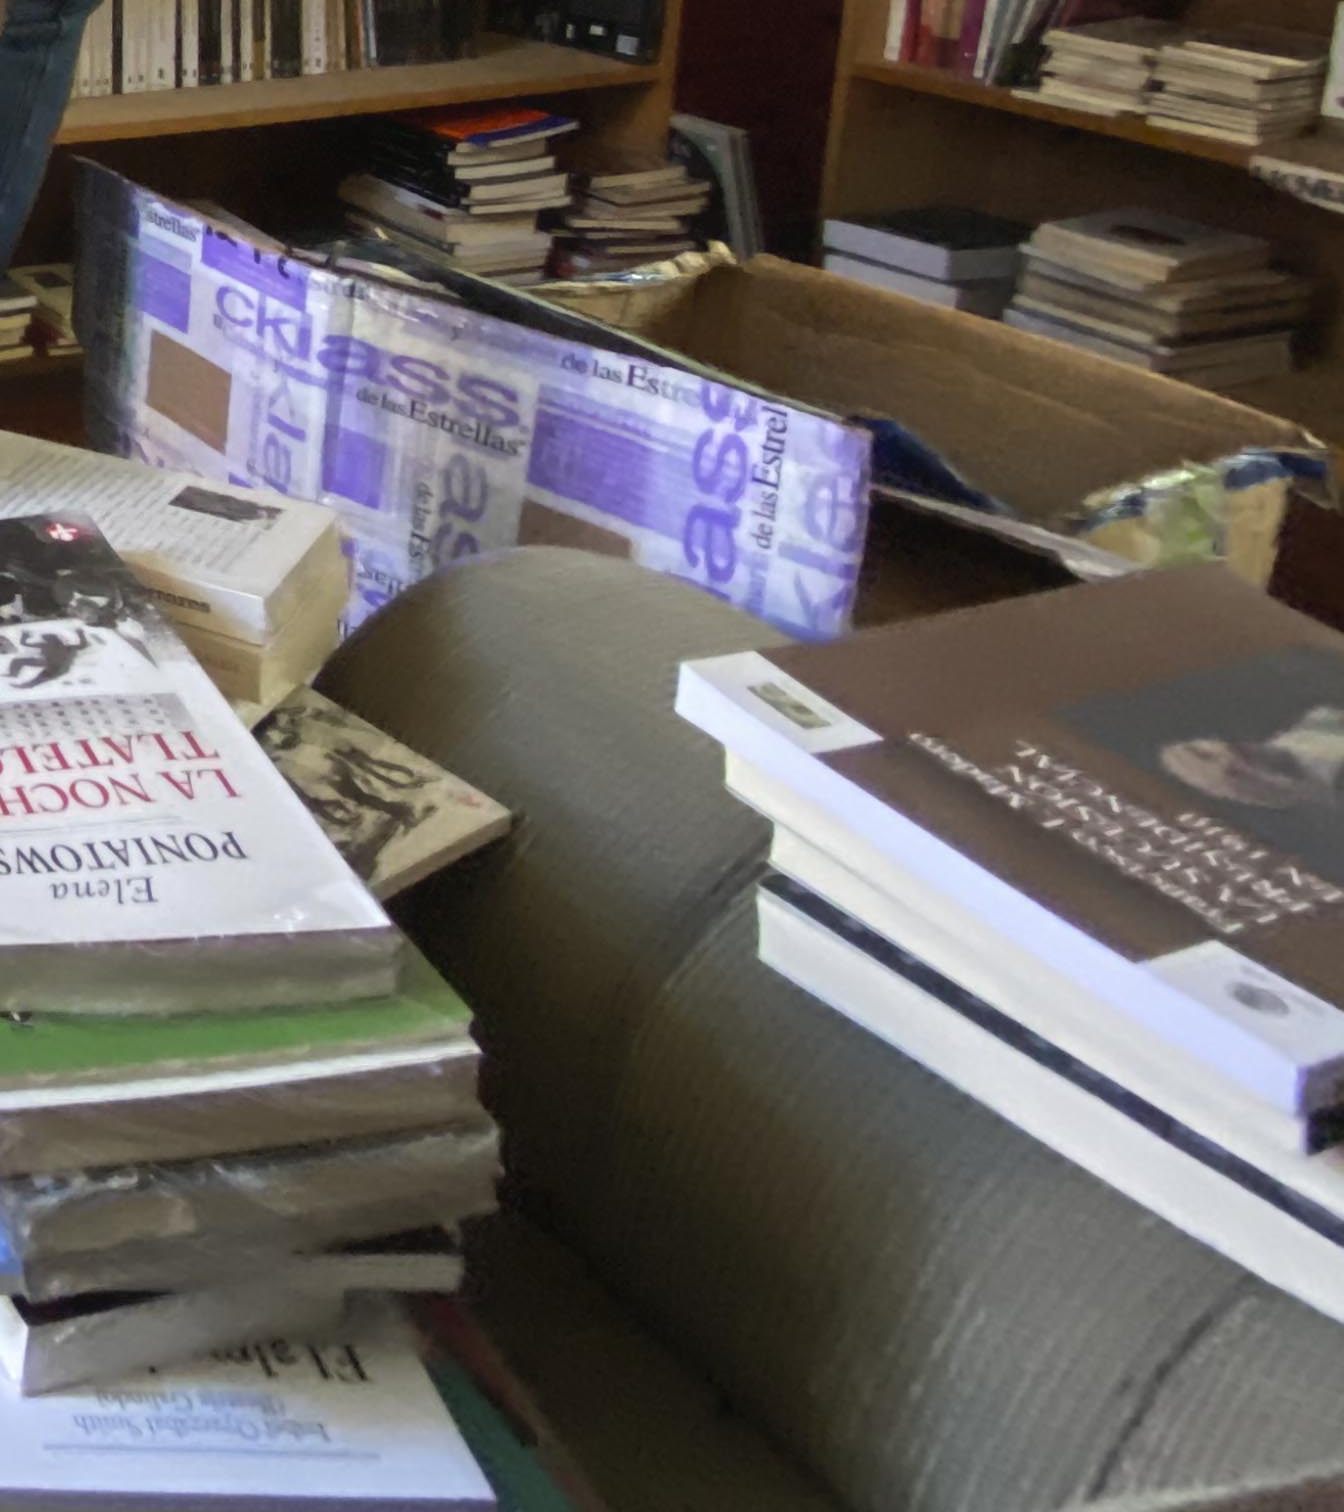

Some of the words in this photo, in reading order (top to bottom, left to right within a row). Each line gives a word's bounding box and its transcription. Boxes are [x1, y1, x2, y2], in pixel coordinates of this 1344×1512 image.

[559, 353, 587, 374] de
[592, 358, 622, 384] las
[356, 387, 379, 406] de
[381, 392, 407, 415] las
[409, 398, 520, 456] Estrellas
[748, 528, 771, 550] de
[760, 490, 778, 526] las
[163, 768, 242, 801] LA
[49, 875, 159, 904] Elena
